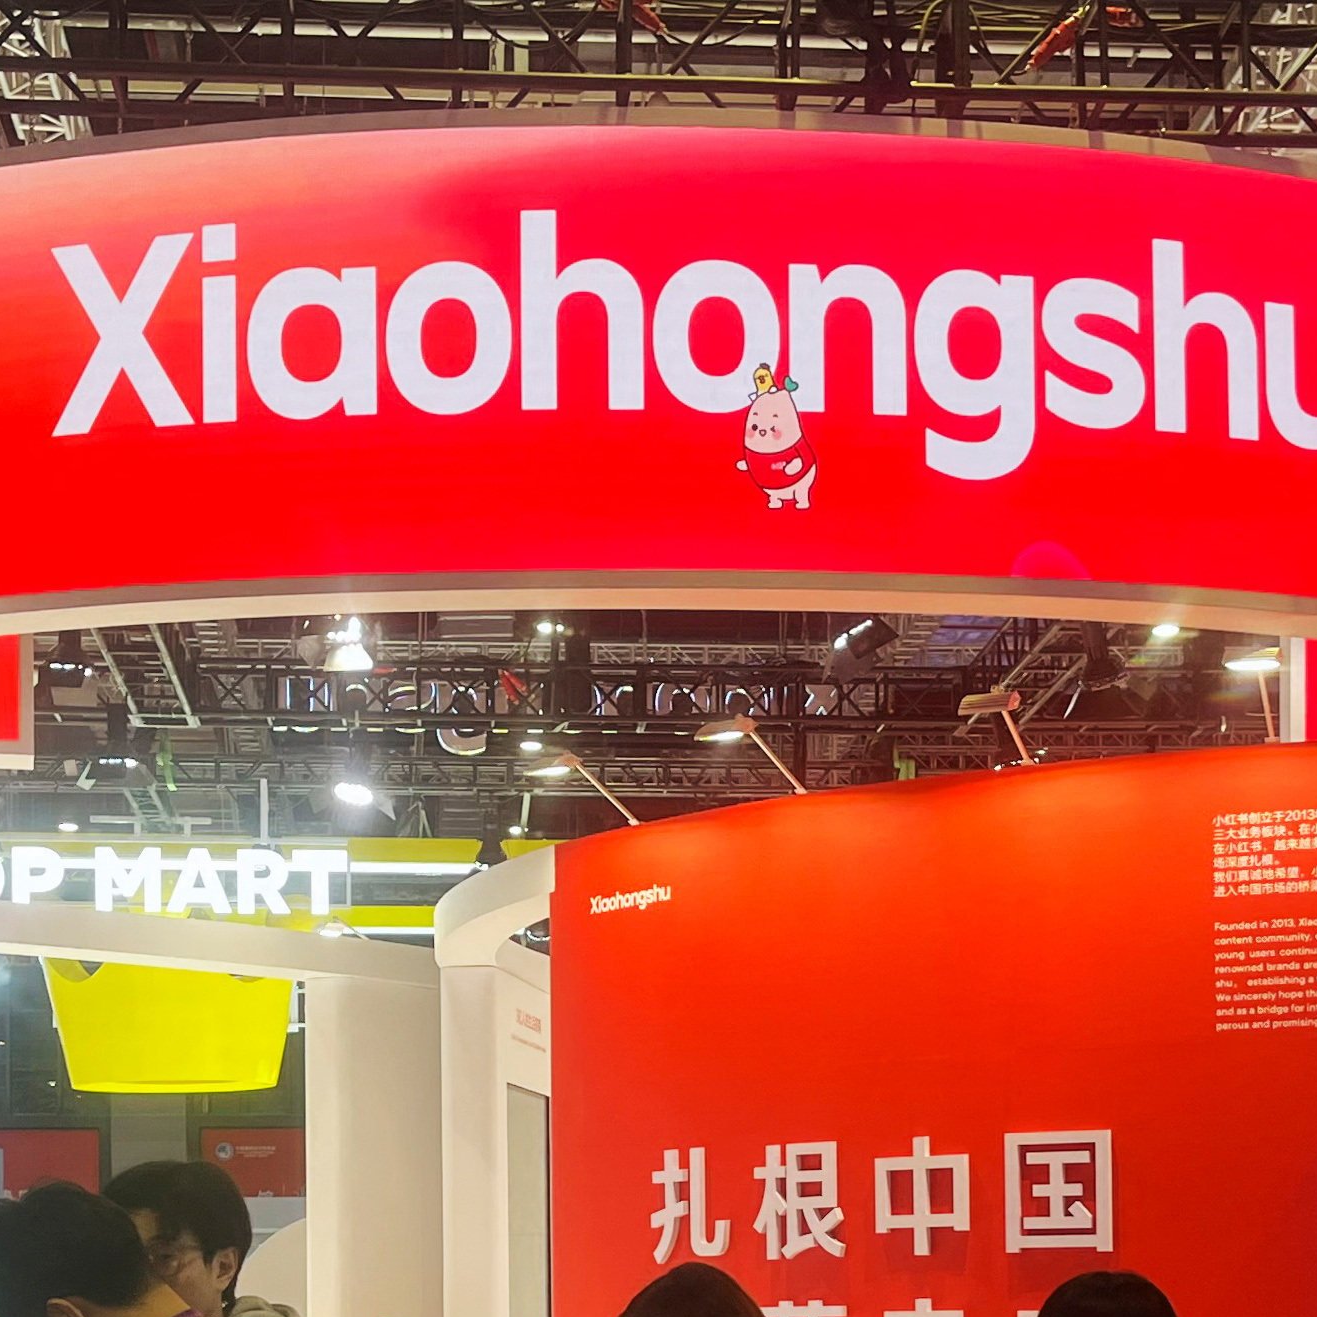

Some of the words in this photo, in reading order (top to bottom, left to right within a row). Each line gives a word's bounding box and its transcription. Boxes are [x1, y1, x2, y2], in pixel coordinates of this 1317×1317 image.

[94, 846, 348, 915] MART
[589, 883, 672, 915] Xiaohongshu
[1214, 920, 1258, 931] Founded
[1258, 919, 1269, 928] in
[1213, 935, 1253, 945] content
[1214, 950, 1246, 961] young
[1248, 949, 1276, 958] users
[1214, 962, 1264, 974] renowned
[1265, 960, 1301, 971] brands
[1246, 974, 1306, 987] establishing
[1307, 975, 1314, 983] a
[1215, 992, 1231, 1002] We
[1232, 990, 1277, 1002] sincerely
[1277, 989, 1304, 1000] hope
[1215, 1006, 1235, 1016] and
[1235, 1007, 1248, 1015] as
[1248, 1006, 1256, 1015] a
[1256, 1003, 1289, 1016] bridge
[1290, 1002, 1305, 1013] for
[1215, 1021, 1250, 1032] perous
[1251, 1019, 1271, 1029] and
[650, 1129, 1114, 1265] 扎根中国
